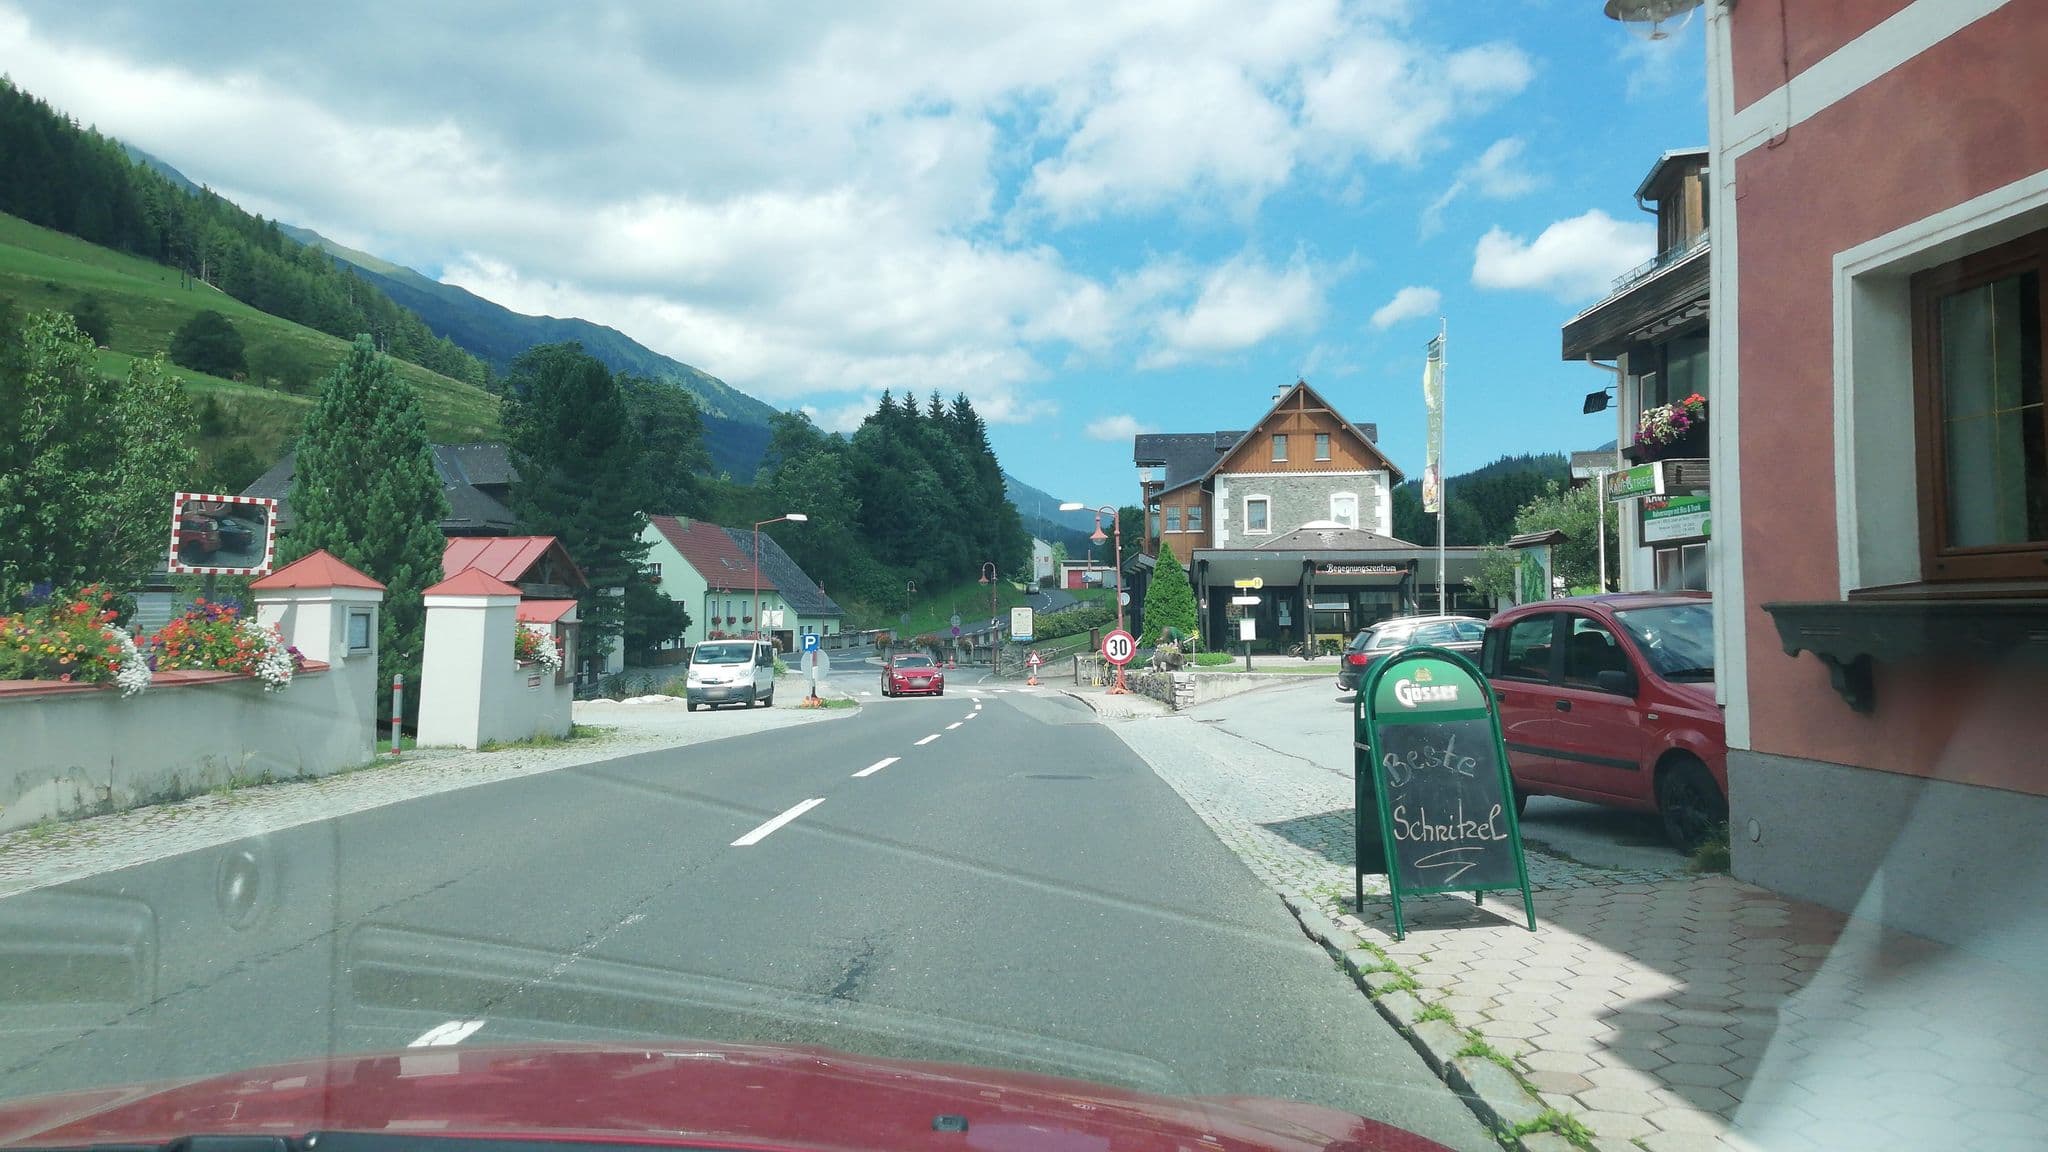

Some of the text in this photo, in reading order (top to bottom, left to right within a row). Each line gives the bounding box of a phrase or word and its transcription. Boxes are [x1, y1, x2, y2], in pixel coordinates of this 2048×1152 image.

[805, 636, 816, 649] P
[1110, 639, 1127, 656] 30
[1394, 679, 1459, 709] Gösser
[1383, 734, 1477, 788] Beste
[1393, 798, 1508, 842] Schnitzel
